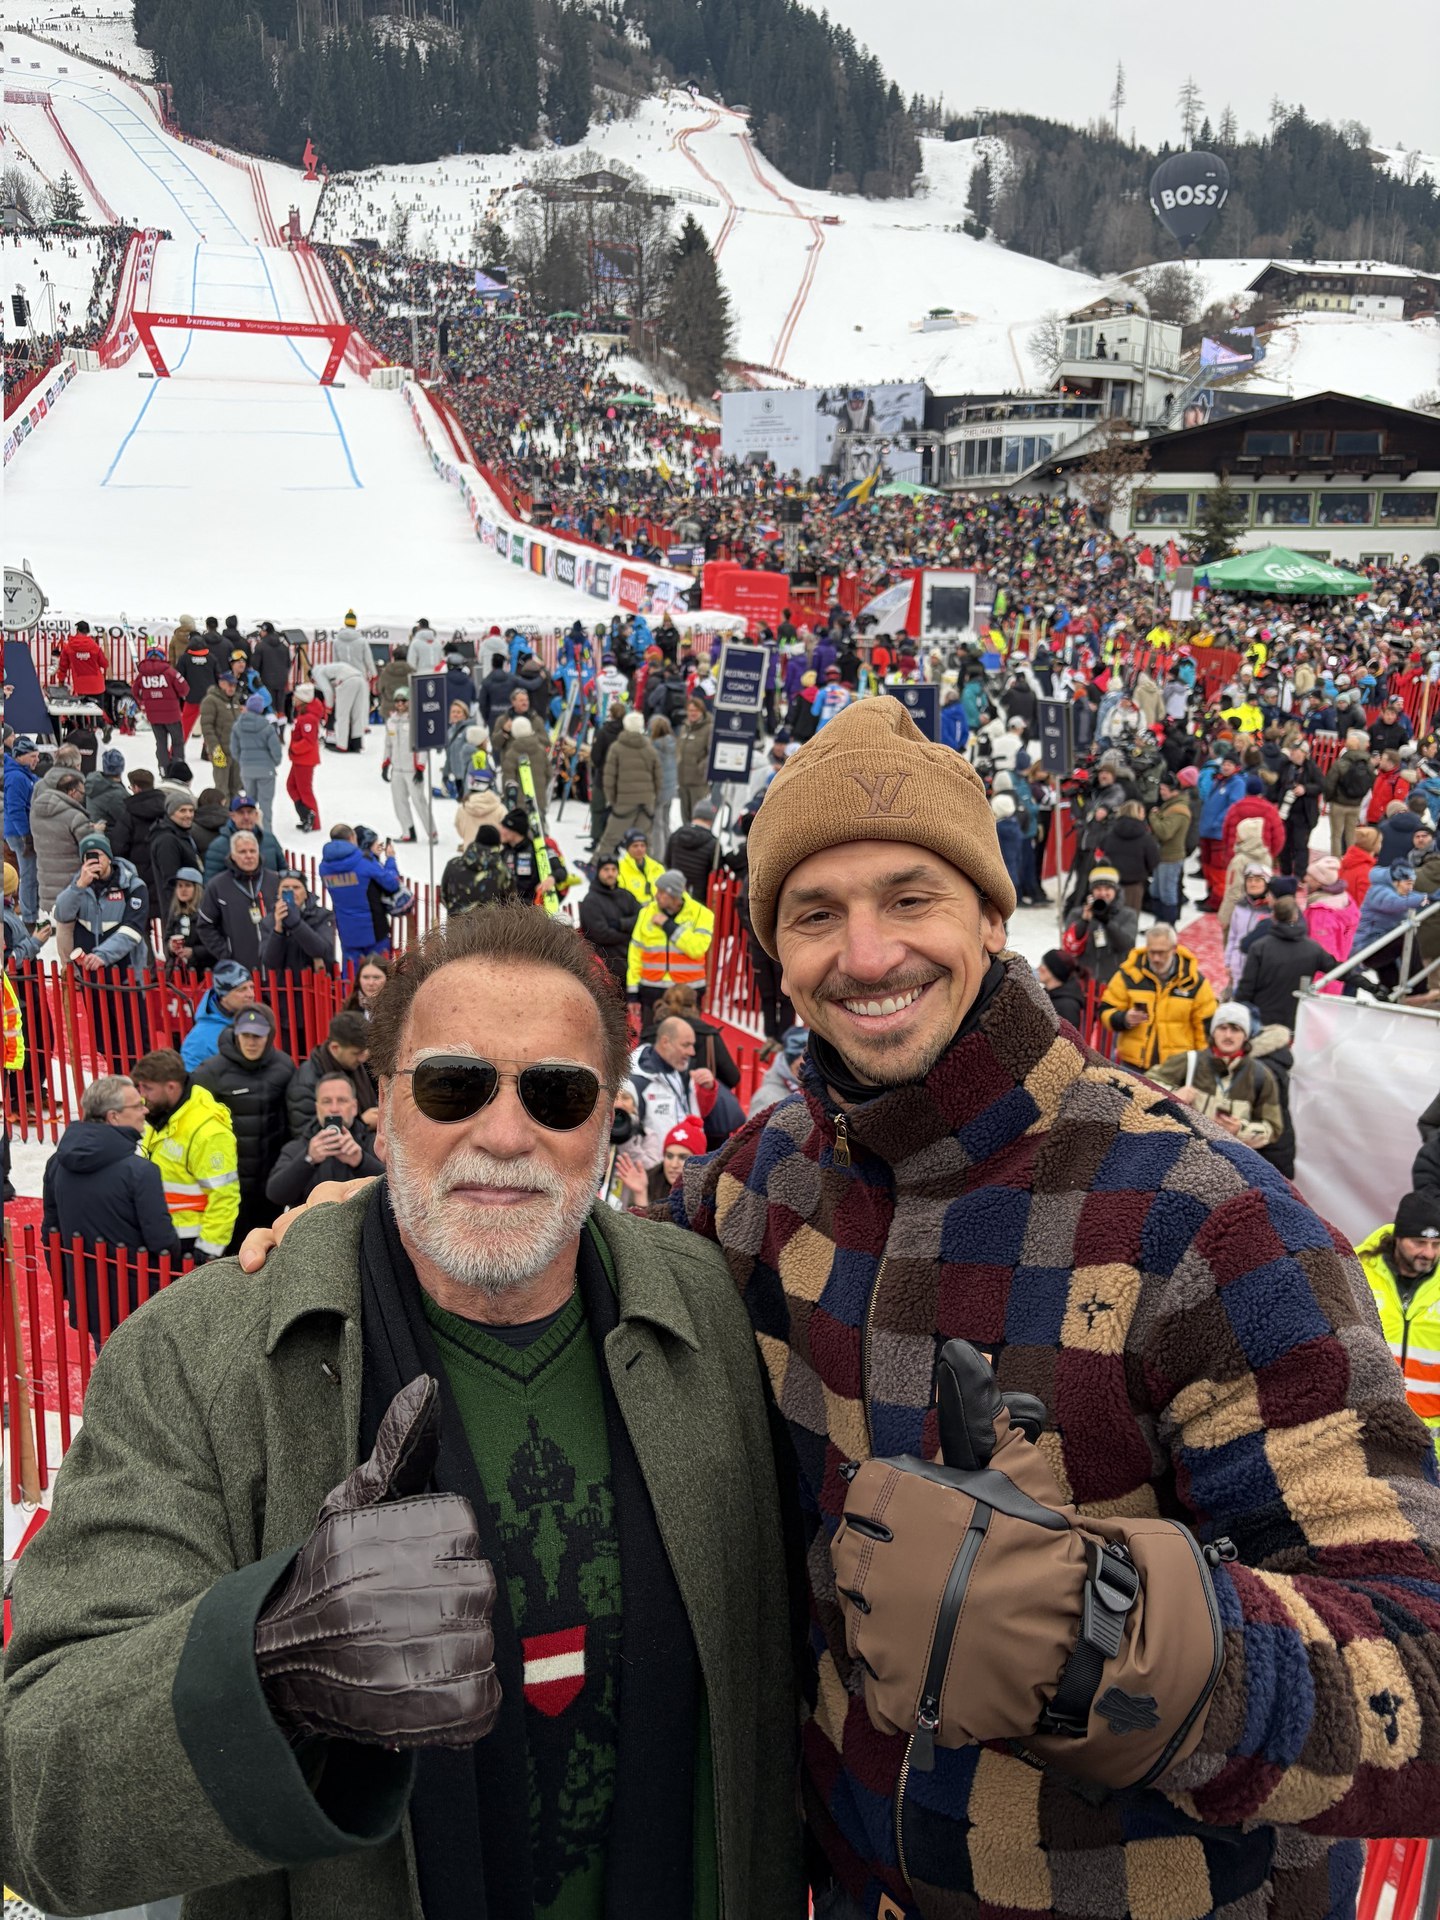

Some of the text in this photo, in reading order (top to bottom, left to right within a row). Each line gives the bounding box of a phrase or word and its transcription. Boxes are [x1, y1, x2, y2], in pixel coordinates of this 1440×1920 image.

[1160, 184, 1219, 210] BOSS
[157, 316, 178, 324] Audi
[245, 322, 279, 331] Vorsprung
[38, 620, 70, 630] LIQUI
[141, 674, 168, 689] USA
[428, 719, 435, 734] 3
